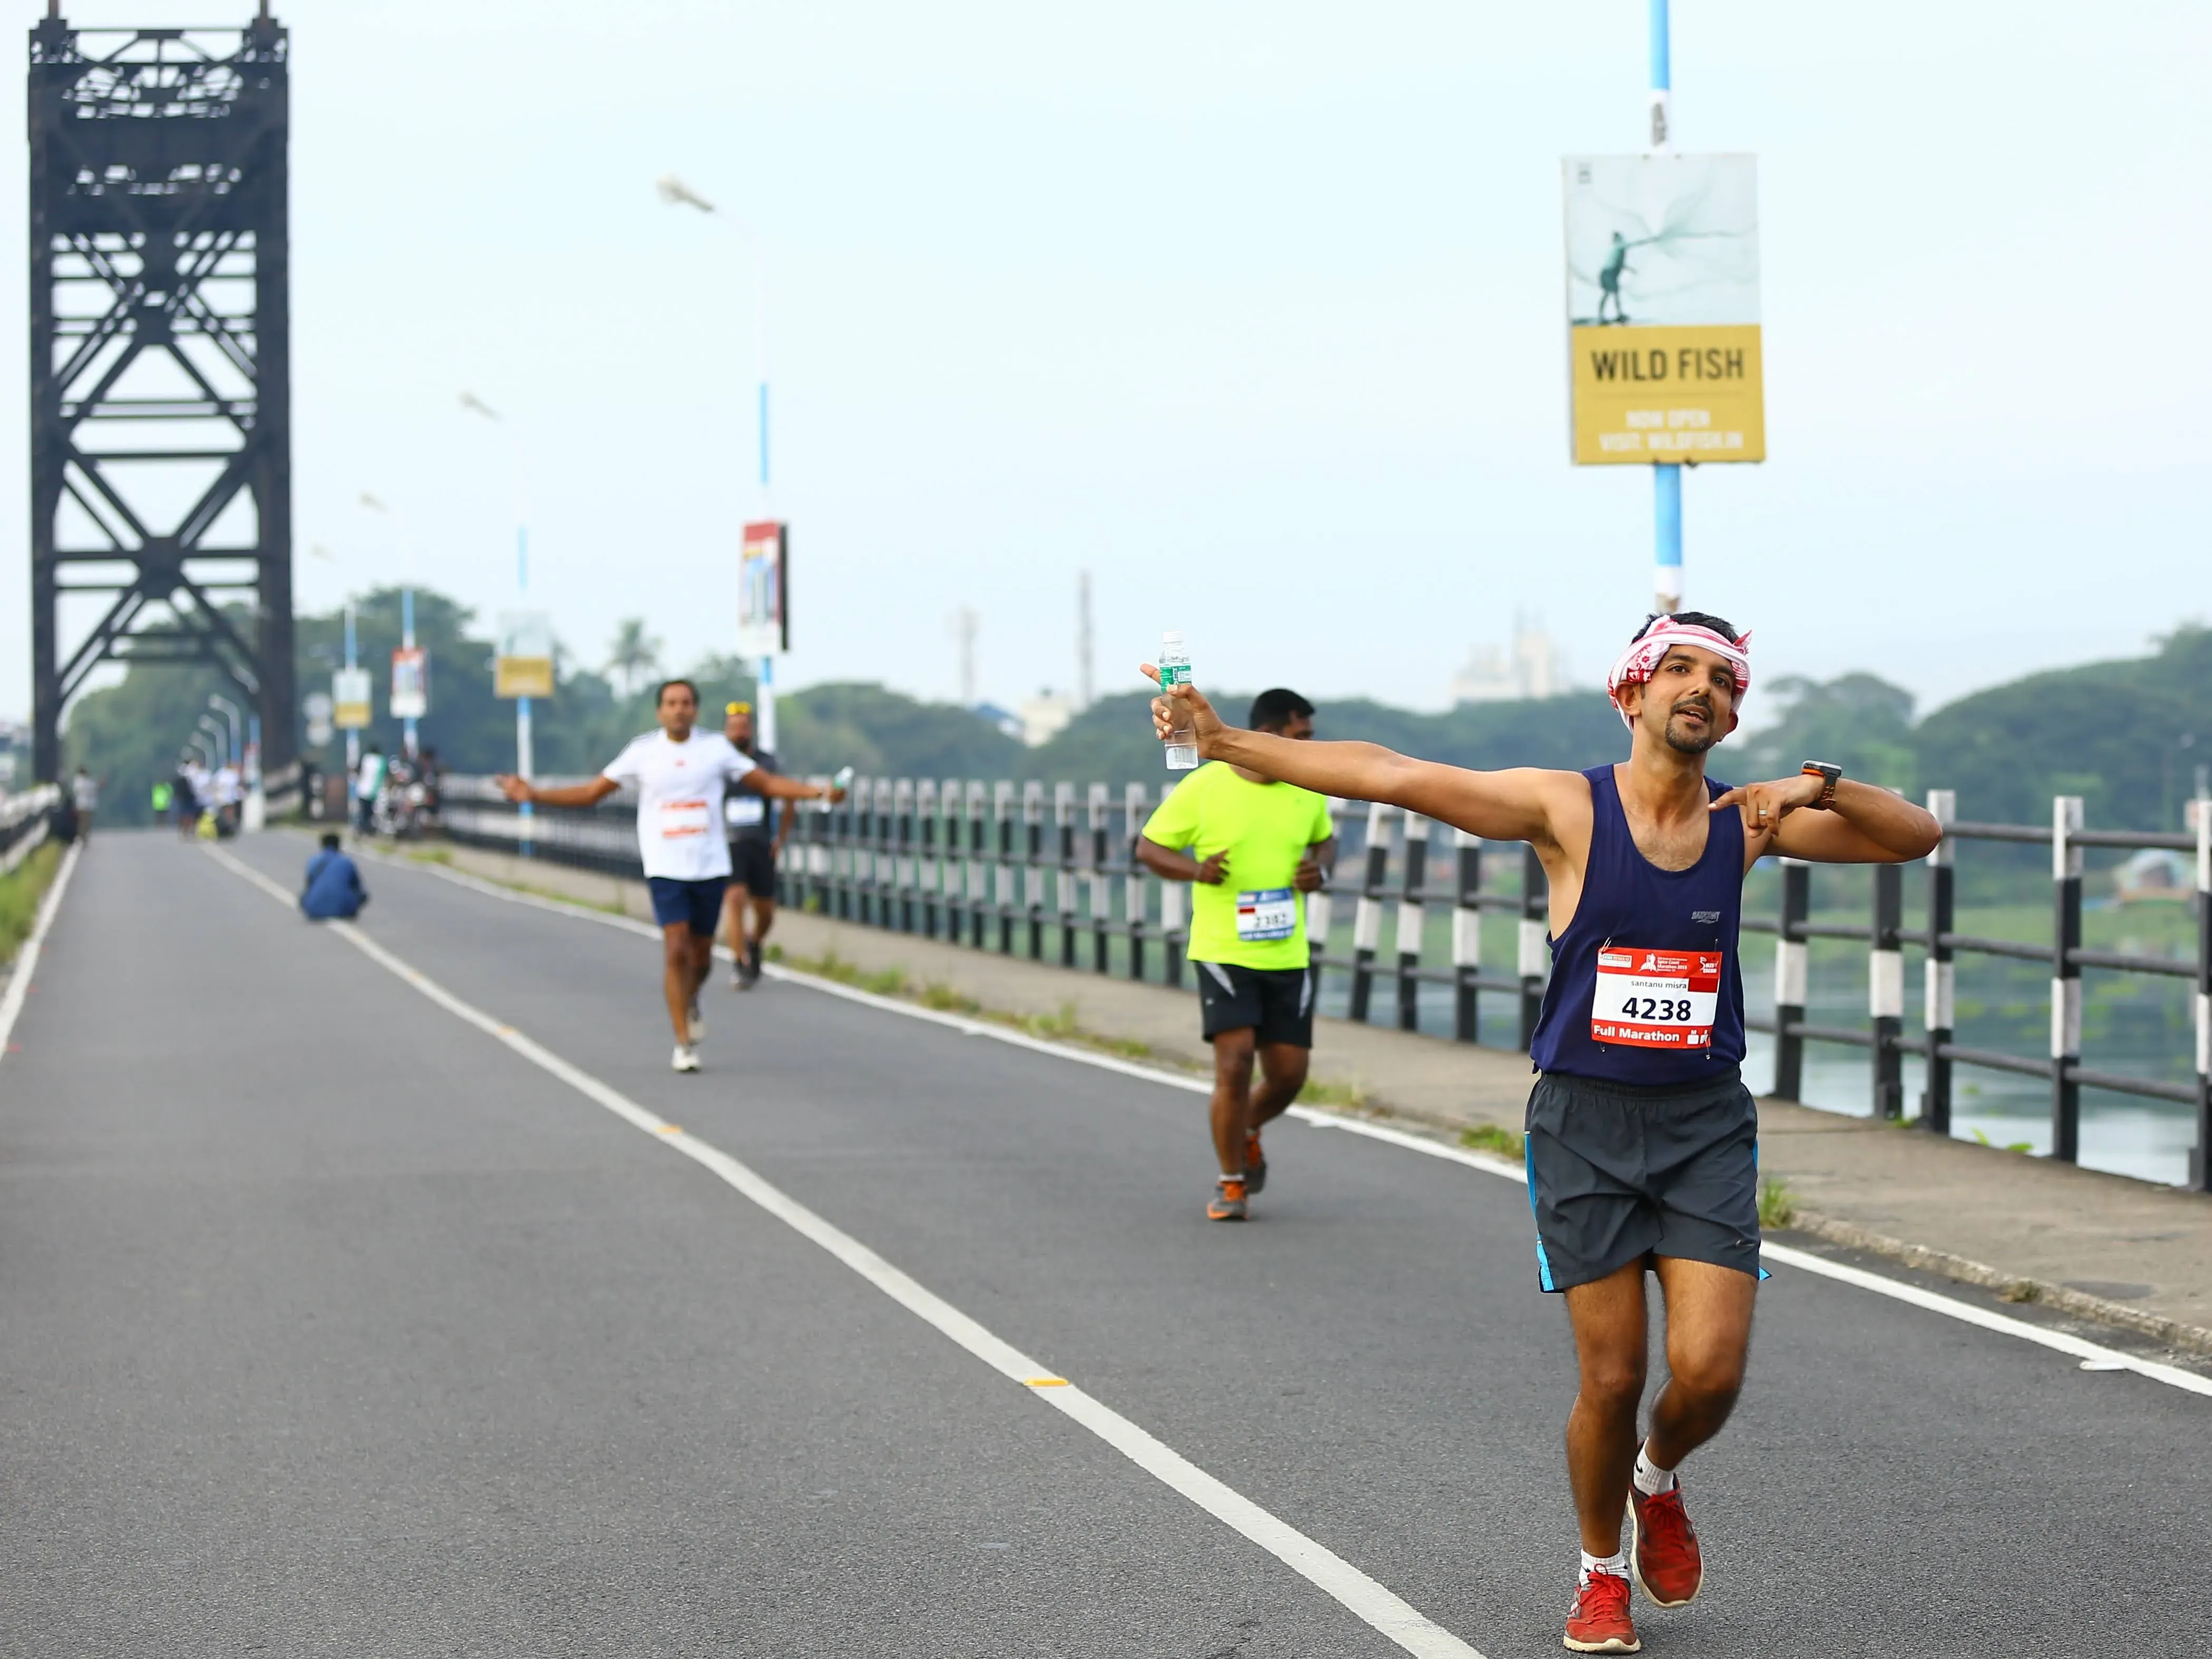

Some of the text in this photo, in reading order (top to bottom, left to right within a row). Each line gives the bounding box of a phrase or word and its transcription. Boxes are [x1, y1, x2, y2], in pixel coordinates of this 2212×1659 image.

[1590, 347, 1744, 382] WILD FISH
[1626, 409, 1709, 427] NOW OPEN
[1622, 997, 1691, 1021] 4238
[1593, 1024, 1680, 1042] Full Marathon
